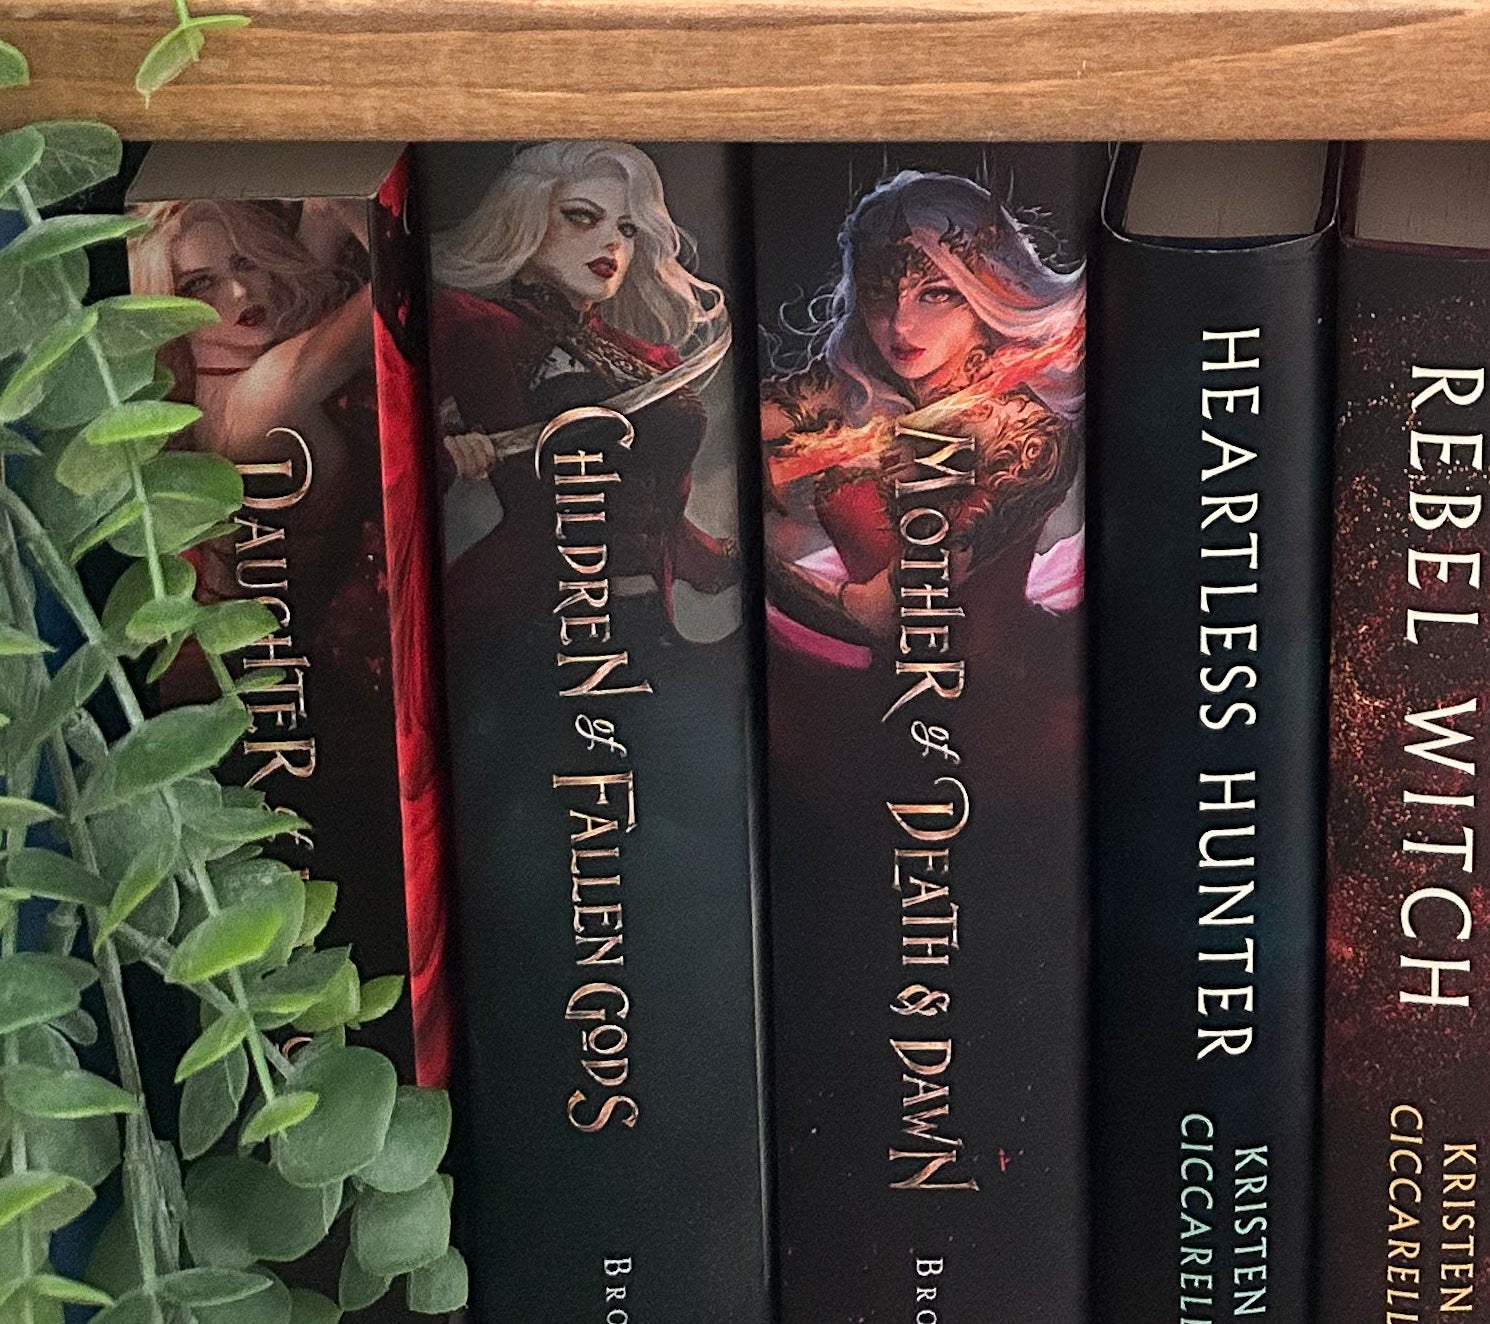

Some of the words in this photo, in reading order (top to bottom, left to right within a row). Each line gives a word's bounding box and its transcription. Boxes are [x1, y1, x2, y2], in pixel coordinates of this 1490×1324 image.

[535, 406, 653, 698] CHILDREN
[882, 425, 976, 723] MOTHER
[1200, 327, 1261, 730] HEARTLESS
[1407, 365, 1485, 645] REBEL
[575, 714, 627, 758] of
[911, 721, 960, 765] of
[553, 770, 639, 967] FALLEN
[886, 776, 971, 965] DEATH
[1197, 770, 1256, 1061] HUNTER
[1400, 698, 1478, 1008] WITCH
[565, 982, 639, 1133] GODS
[890, 984, 951, 1017] &
[889, 1038, 980, 1192] DAWN
[1234, 1145, 1268, 1315] KRISTEN
[1439, 1143, 1477, 1313] KRISTEN
